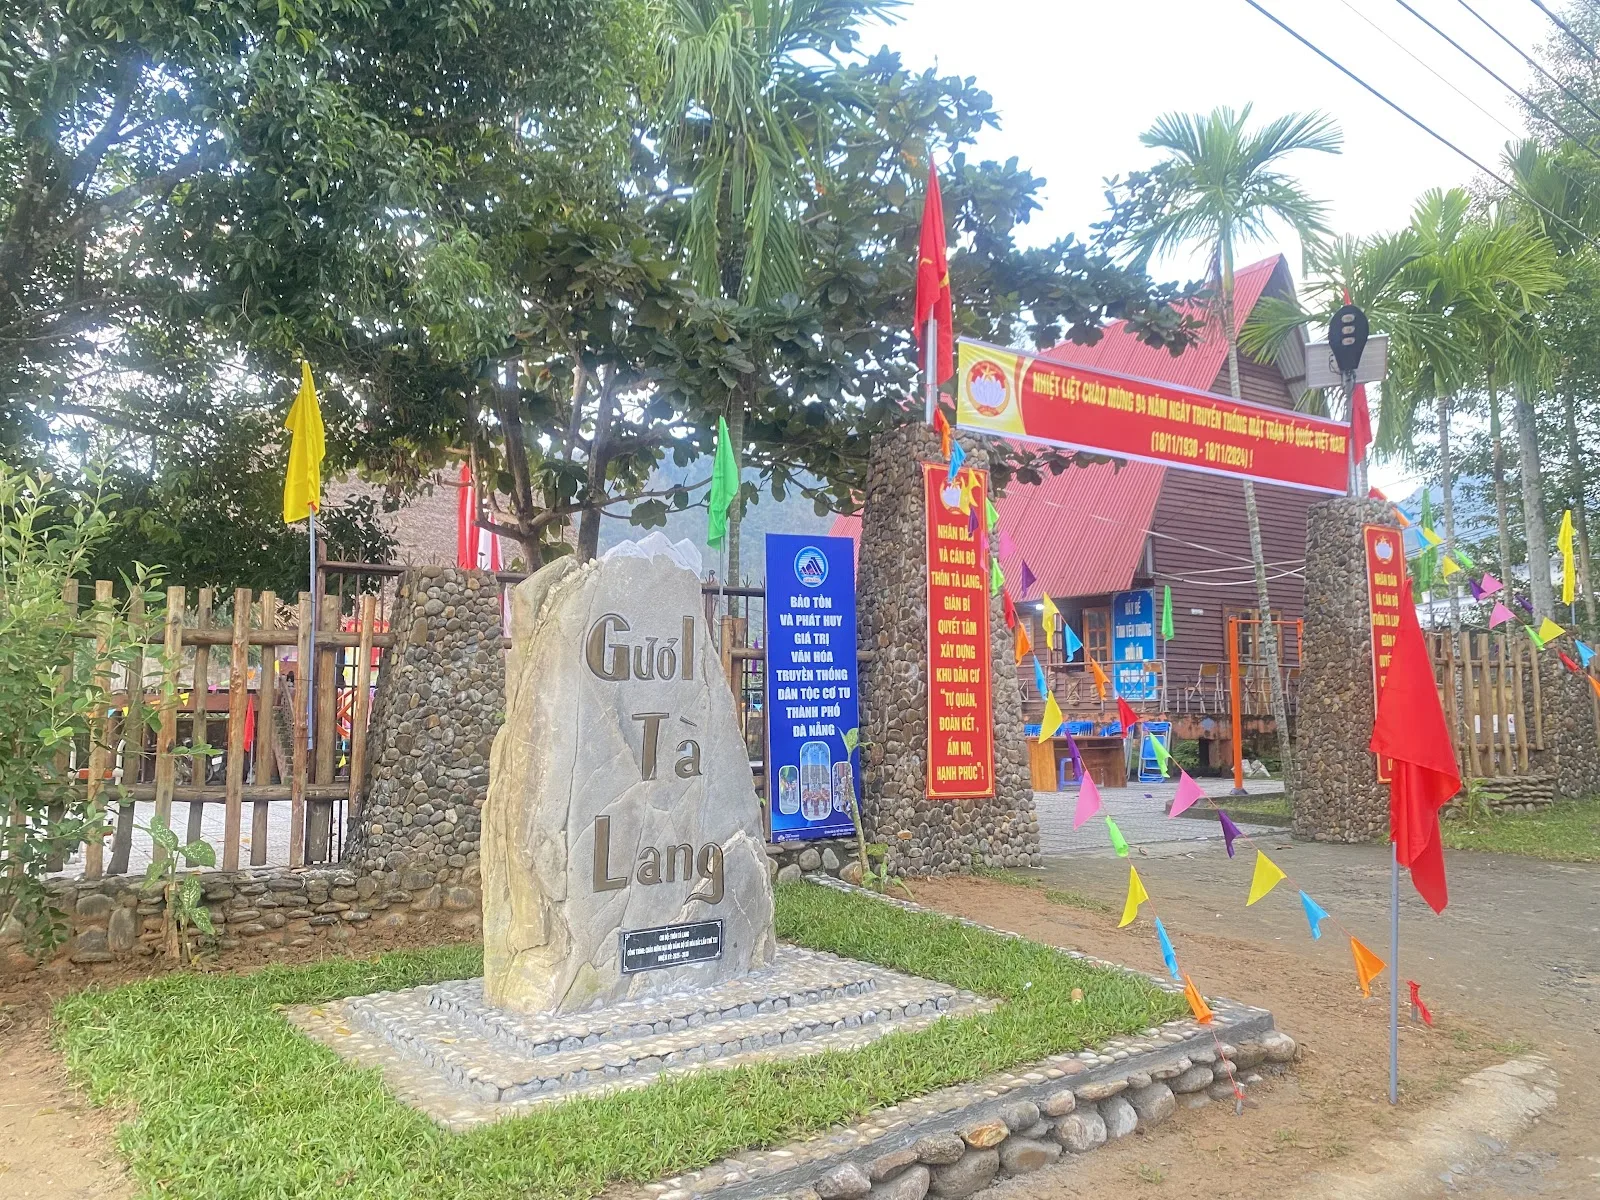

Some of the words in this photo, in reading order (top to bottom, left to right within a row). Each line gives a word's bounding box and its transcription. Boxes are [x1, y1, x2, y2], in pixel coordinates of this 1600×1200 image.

[1032, 372, 1060, 400] NHIỆT
[1062, 376, 1081, 405] LIỆT
[1082, 381, 1106, 407] CHÀO
[1108, 385, 1134, 412] MỪNG
[1136, 394, 1147, 414] 94
[1148, 393, 1167, 418] NĂM
[1169, 398, 1190, 423] NGÀY
[1223, 408, 1247, 434] THỐNG
[1249, 416, 1264, 442] MẶT
[1266, 418, 1285, 445] TRẬN
[1286, 419, 1295, 442] TỔ
[1295, 424, 1314, 448] QUỐC
[1315, 428, 1330, 454] VIỆT
[1151, 431, 1198, 458] (18/11/1930
[938, 523, 957, 540] NHÂN
[939, 546, 948, 562] VÀ
[950, 548, 965, 564] CÁN
[966, 548, 976, 568] BỘ
[931, 569, 950, 586] THÔN
[951, 570, 960, 587] TÀ
[961, 575, 982, 591] LANG,
[790, 594, 810, 608] BẢO
[813, 594, 832, 608] TỒN
[780, 613, 794, 626] VÀ
[796, 613, 821, 626] PHÁT
[823, 615, 843, 627] HUY
[938, 616, 960, 635] QUYẾT
[962, 618, 977, 635] TÂM
[794, 632, 812, 644] GIÁ
[813, 633, 829, 646] TRỊ
[791, 650, 811, 662] VĂN
[813, 650, 833, 662] HÓA
[941, 642, 955, 658] XÂY
[956, 644, 976, 661] DỰNG
[776, 666, 814, 681] TRUYỀN
[816, 665, 848, 681] THỐNG
[936, 668, 952, 683] KHU
[953, 666, 968, 683] DÂN
[970, 668, 980, 683] CƯ
[777, 687, 798, 700] DÂN
[800, 686, 821, 702] TỘC
[822, 686, 837, 699] CƠ
[838, 687, 850, 698] TU
[786, 706, 818, 719] THÀNH
[821, 702, 840, 718] PHỐ
[793, 724, 807, 738] ĐÀ
[809, 722, 835, 736] NẴNG
[939, 714, 960, 732] ĐOÀN
[632, 712, 703, 781] Tà
[947, 737, 959, 756] ẤM
[961, 741, 973, 757] NO,
[936, 766, 957, 784] HẠNH
[592, 814, 724, 905] Lang
